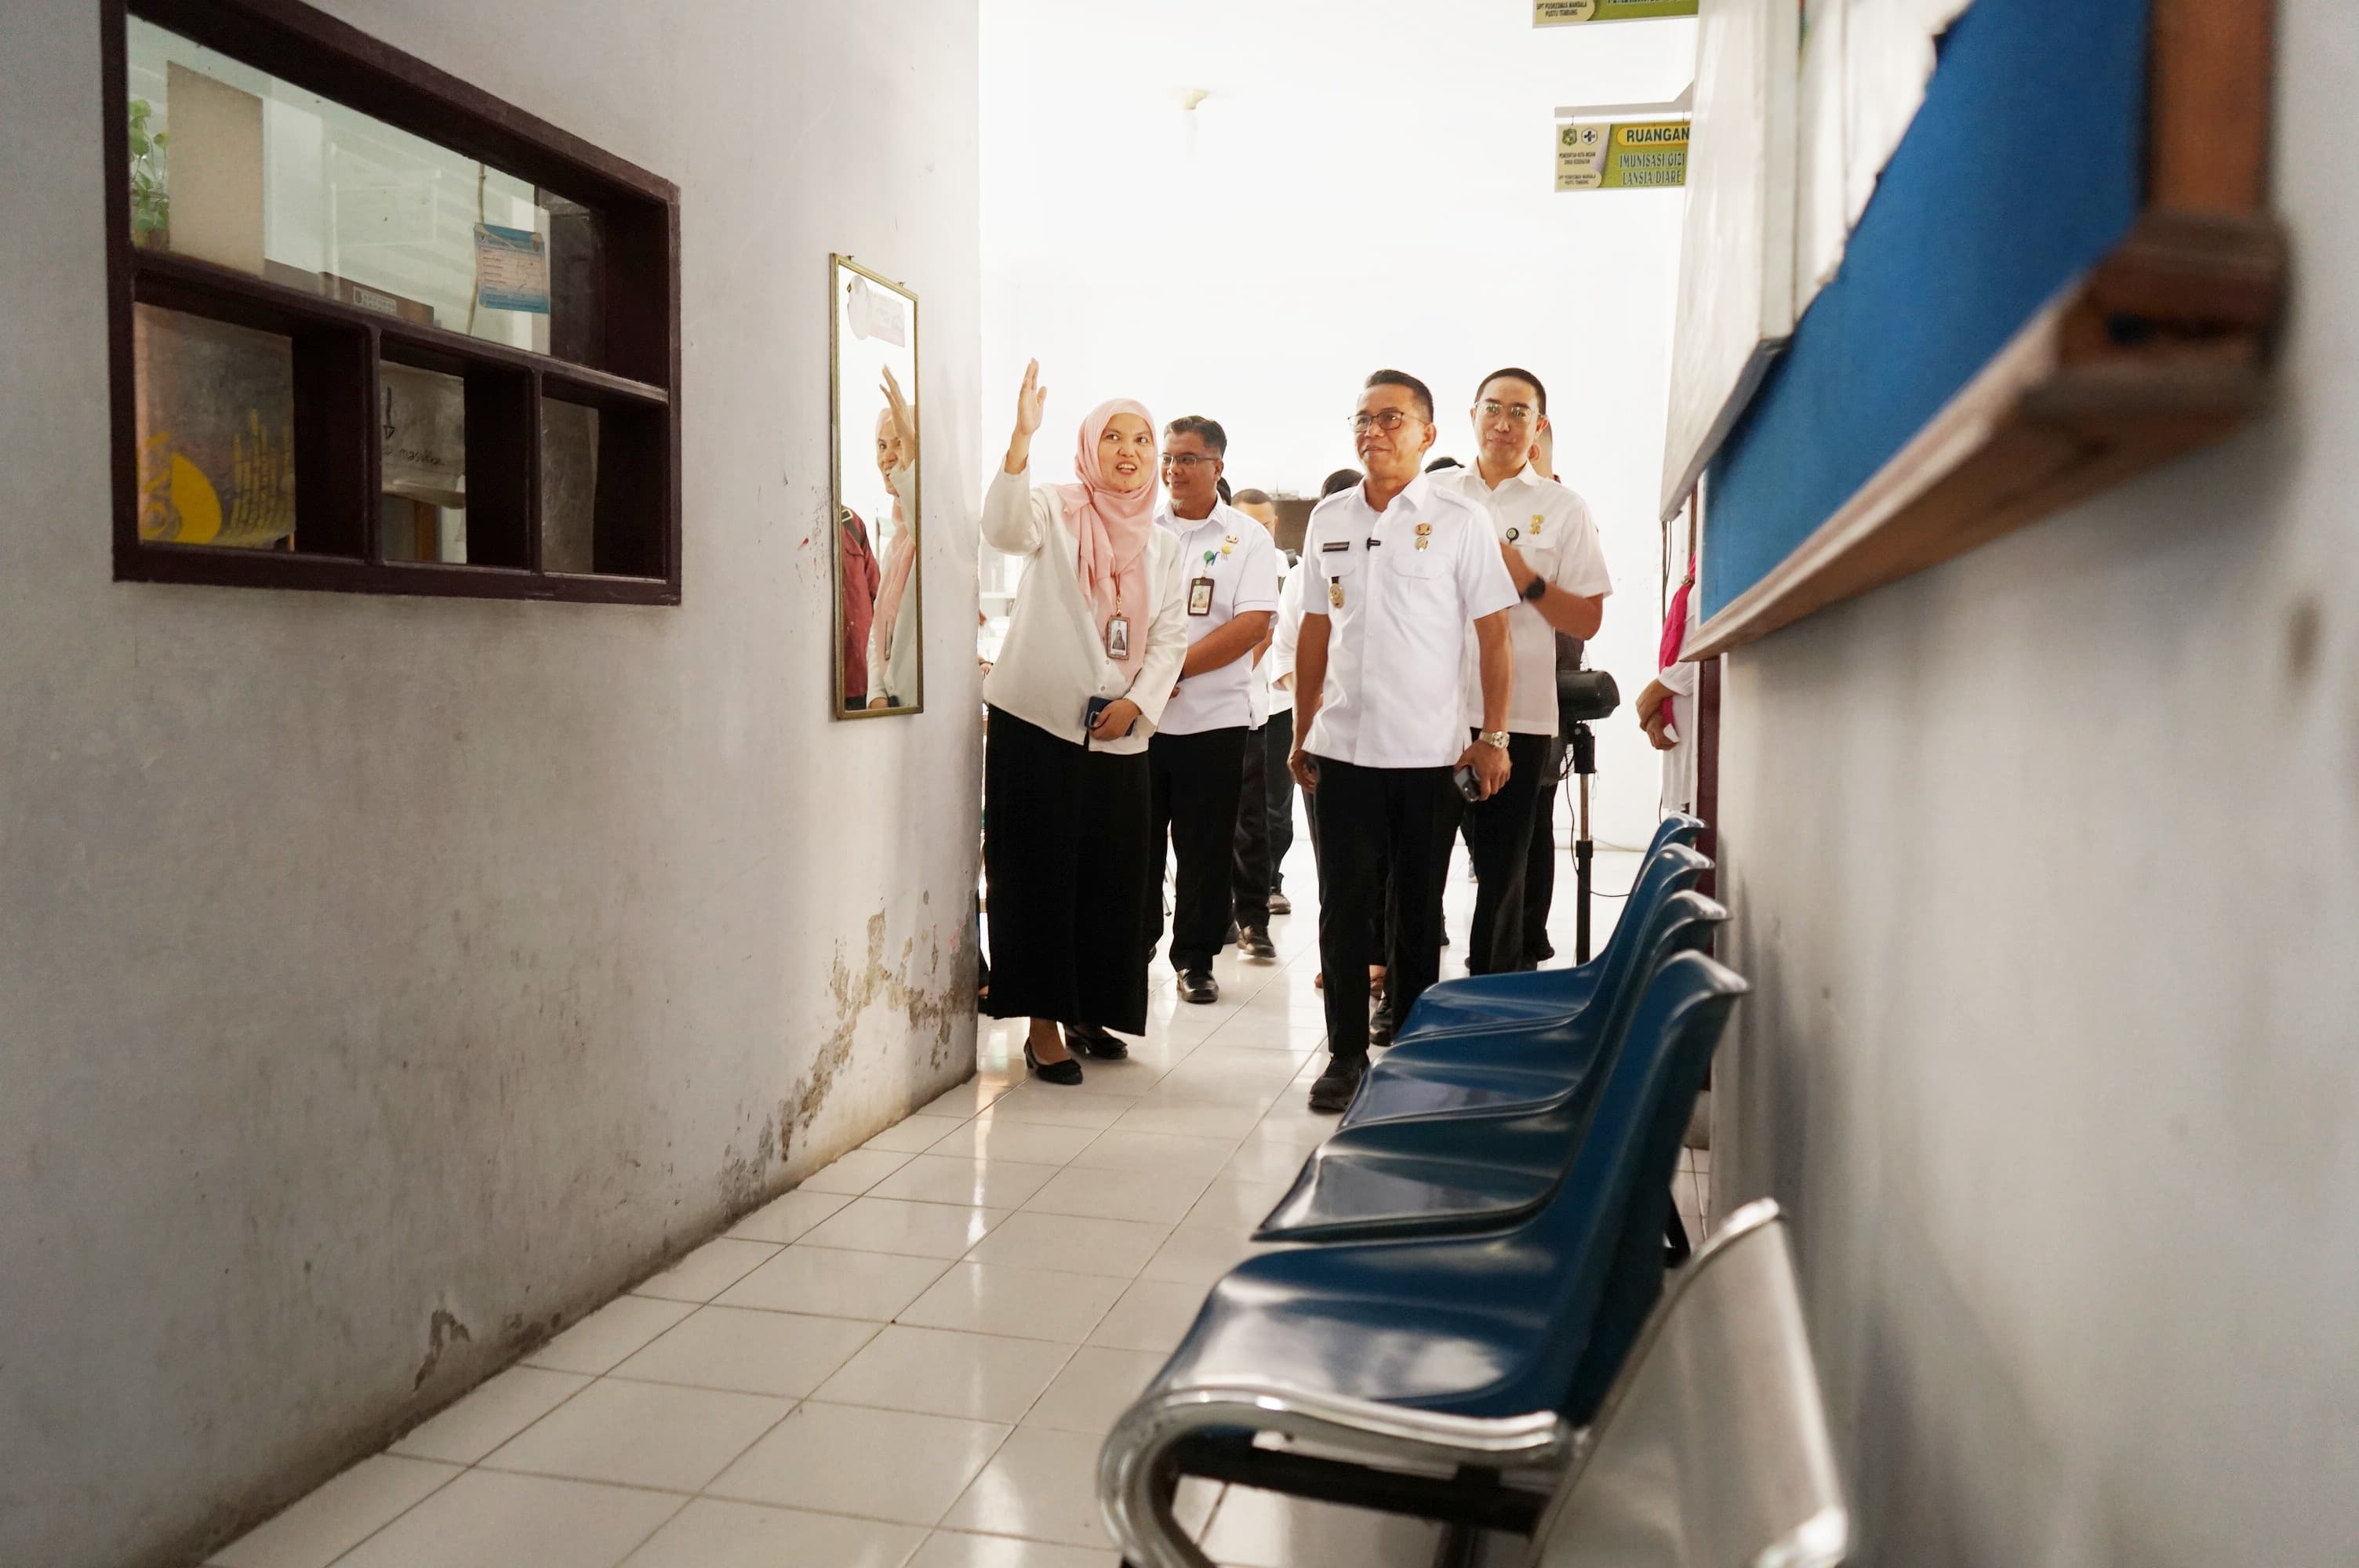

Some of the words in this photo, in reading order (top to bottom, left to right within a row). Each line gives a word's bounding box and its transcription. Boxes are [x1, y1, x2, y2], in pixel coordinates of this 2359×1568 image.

[1626, 127, 1690, 143] RUANGAN
[1619, 153, 1665, 168] IMUNISASI
[1656, 170, 1682, 183] DIARE
